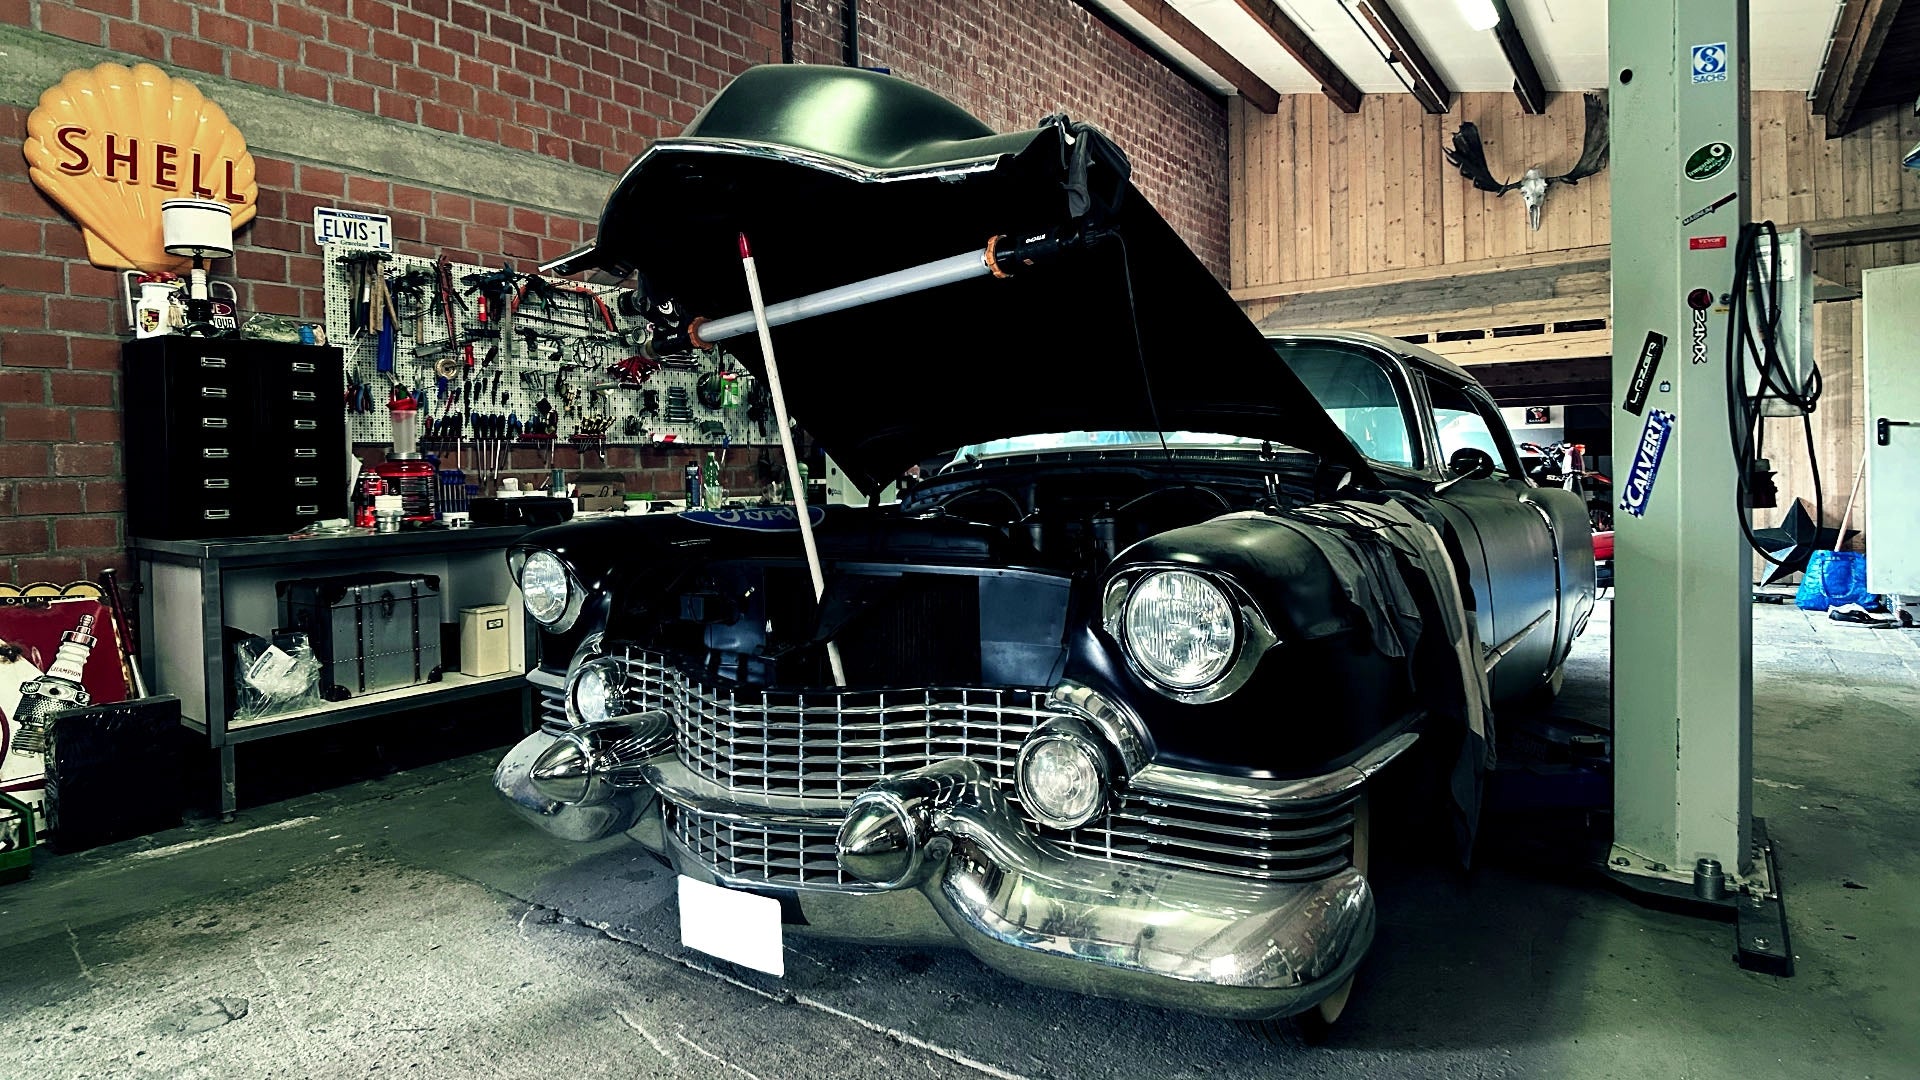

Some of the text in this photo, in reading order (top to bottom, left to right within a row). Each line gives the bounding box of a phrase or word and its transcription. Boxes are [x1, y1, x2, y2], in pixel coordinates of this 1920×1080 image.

[1693, 73, 1726, 84] SACHS
[57, 127, 245, 202] SHELL
[1694, 309, 1706, 363] 24MX
[1626, 415, 1663, 507] CALVERT
[50, 666, 82, 678] CHAMPION
